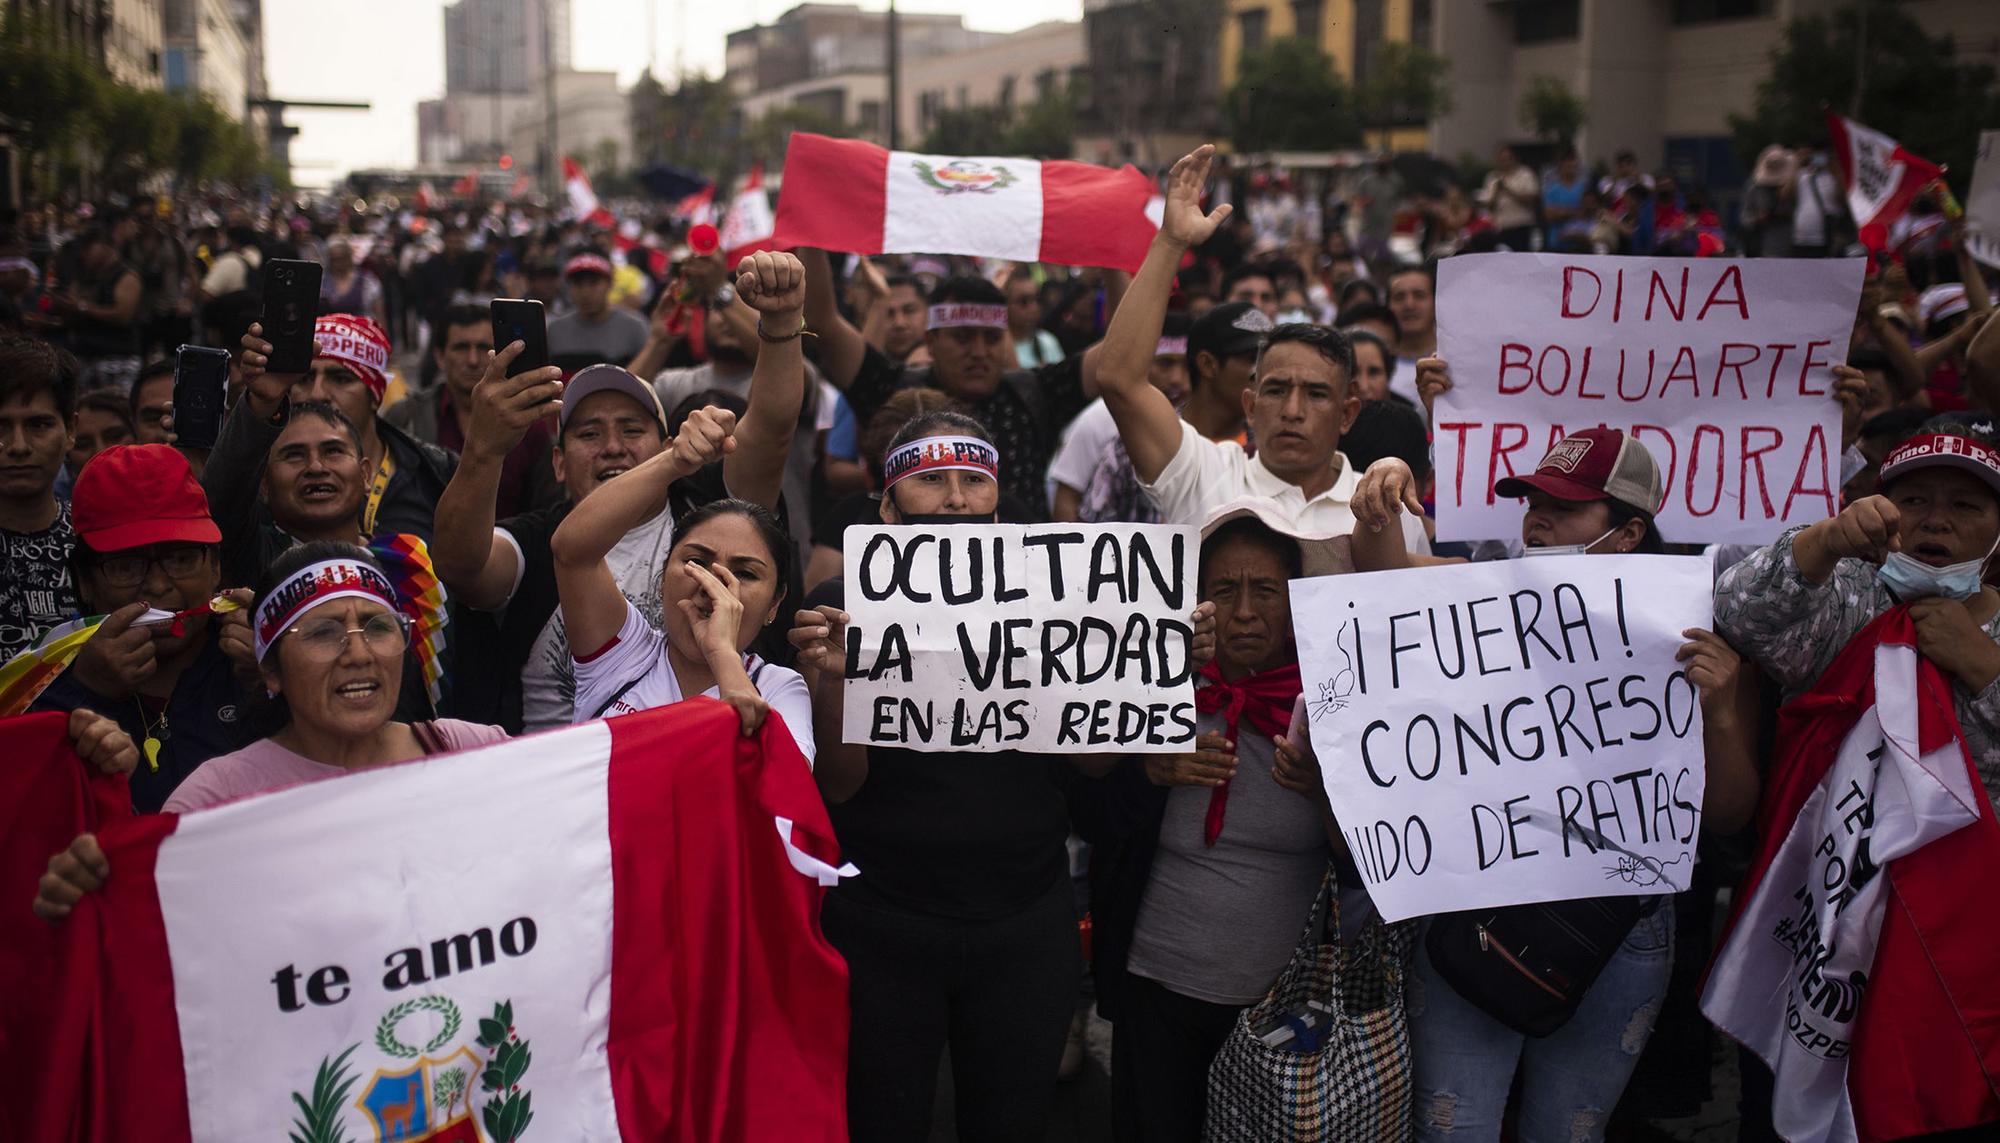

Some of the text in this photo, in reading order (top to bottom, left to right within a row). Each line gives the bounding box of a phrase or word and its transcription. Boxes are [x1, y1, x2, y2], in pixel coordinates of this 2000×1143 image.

[1561, 264, 1749, 322] DINA
[341, 337, 384, 366] PERU
[1497, 339, 1832, 403] BOLUARTE
[952, 442, 994, 470] PERU
[1439, 422, 1836, 522] TRDORA
[859, 531, 1185, 611] OCULTAN
[845, 611, 1193, 692] LA VERDAD
[870, 695, 1197, 747] EN LAS REDES
[1361, 669, 1698, 788] CONGRESO
[1471, 794, 1540, 871] DE
[1556, 766, 1702, 858] RATAS
[271, 916, 538, 1012] te amo
